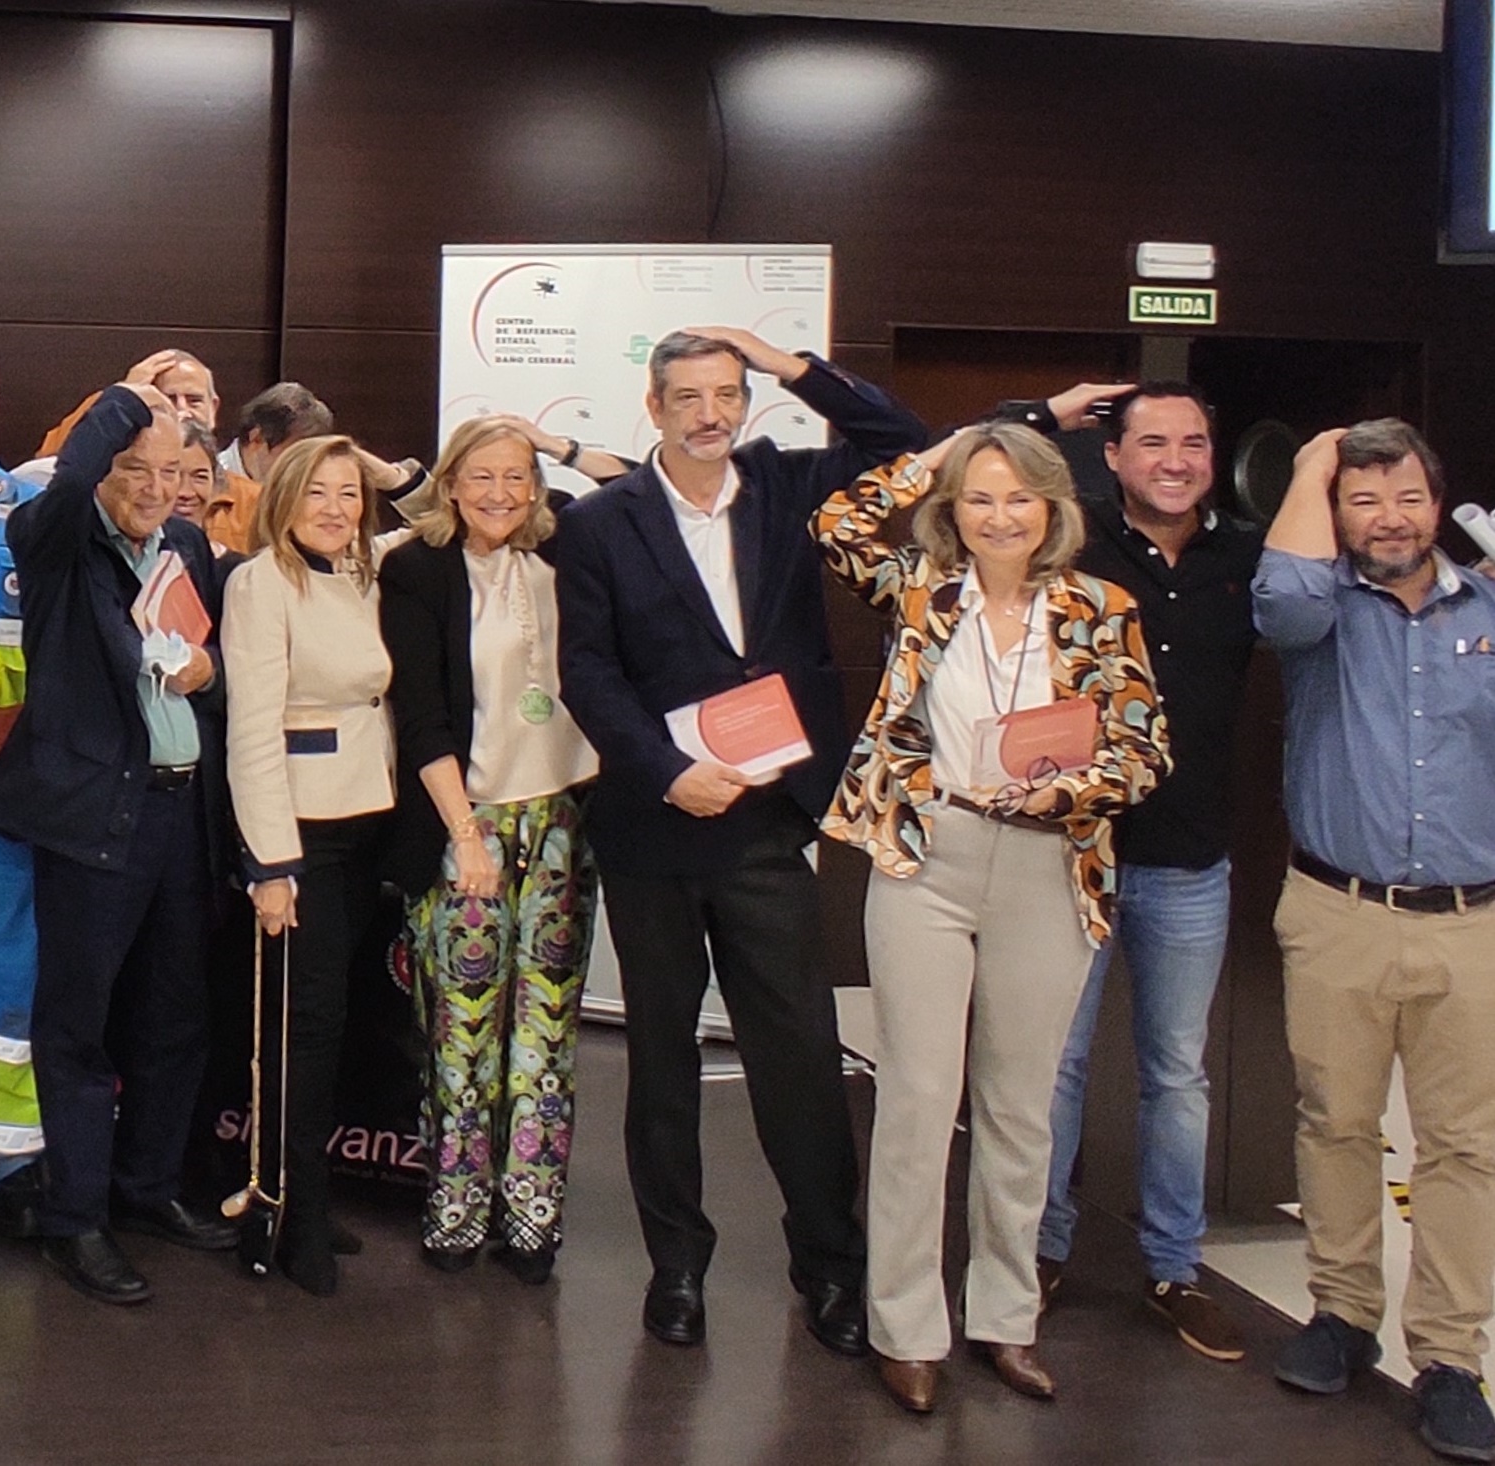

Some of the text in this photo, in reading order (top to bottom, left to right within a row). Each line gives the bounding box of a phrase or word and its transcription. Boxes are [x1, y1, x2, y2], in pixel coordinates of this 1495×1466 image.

[1139, 295, 1207, 315] SALIDA
[495, 317, 533, 325] CENTRO
[528, 356, 576, 365] CEREBRAL
